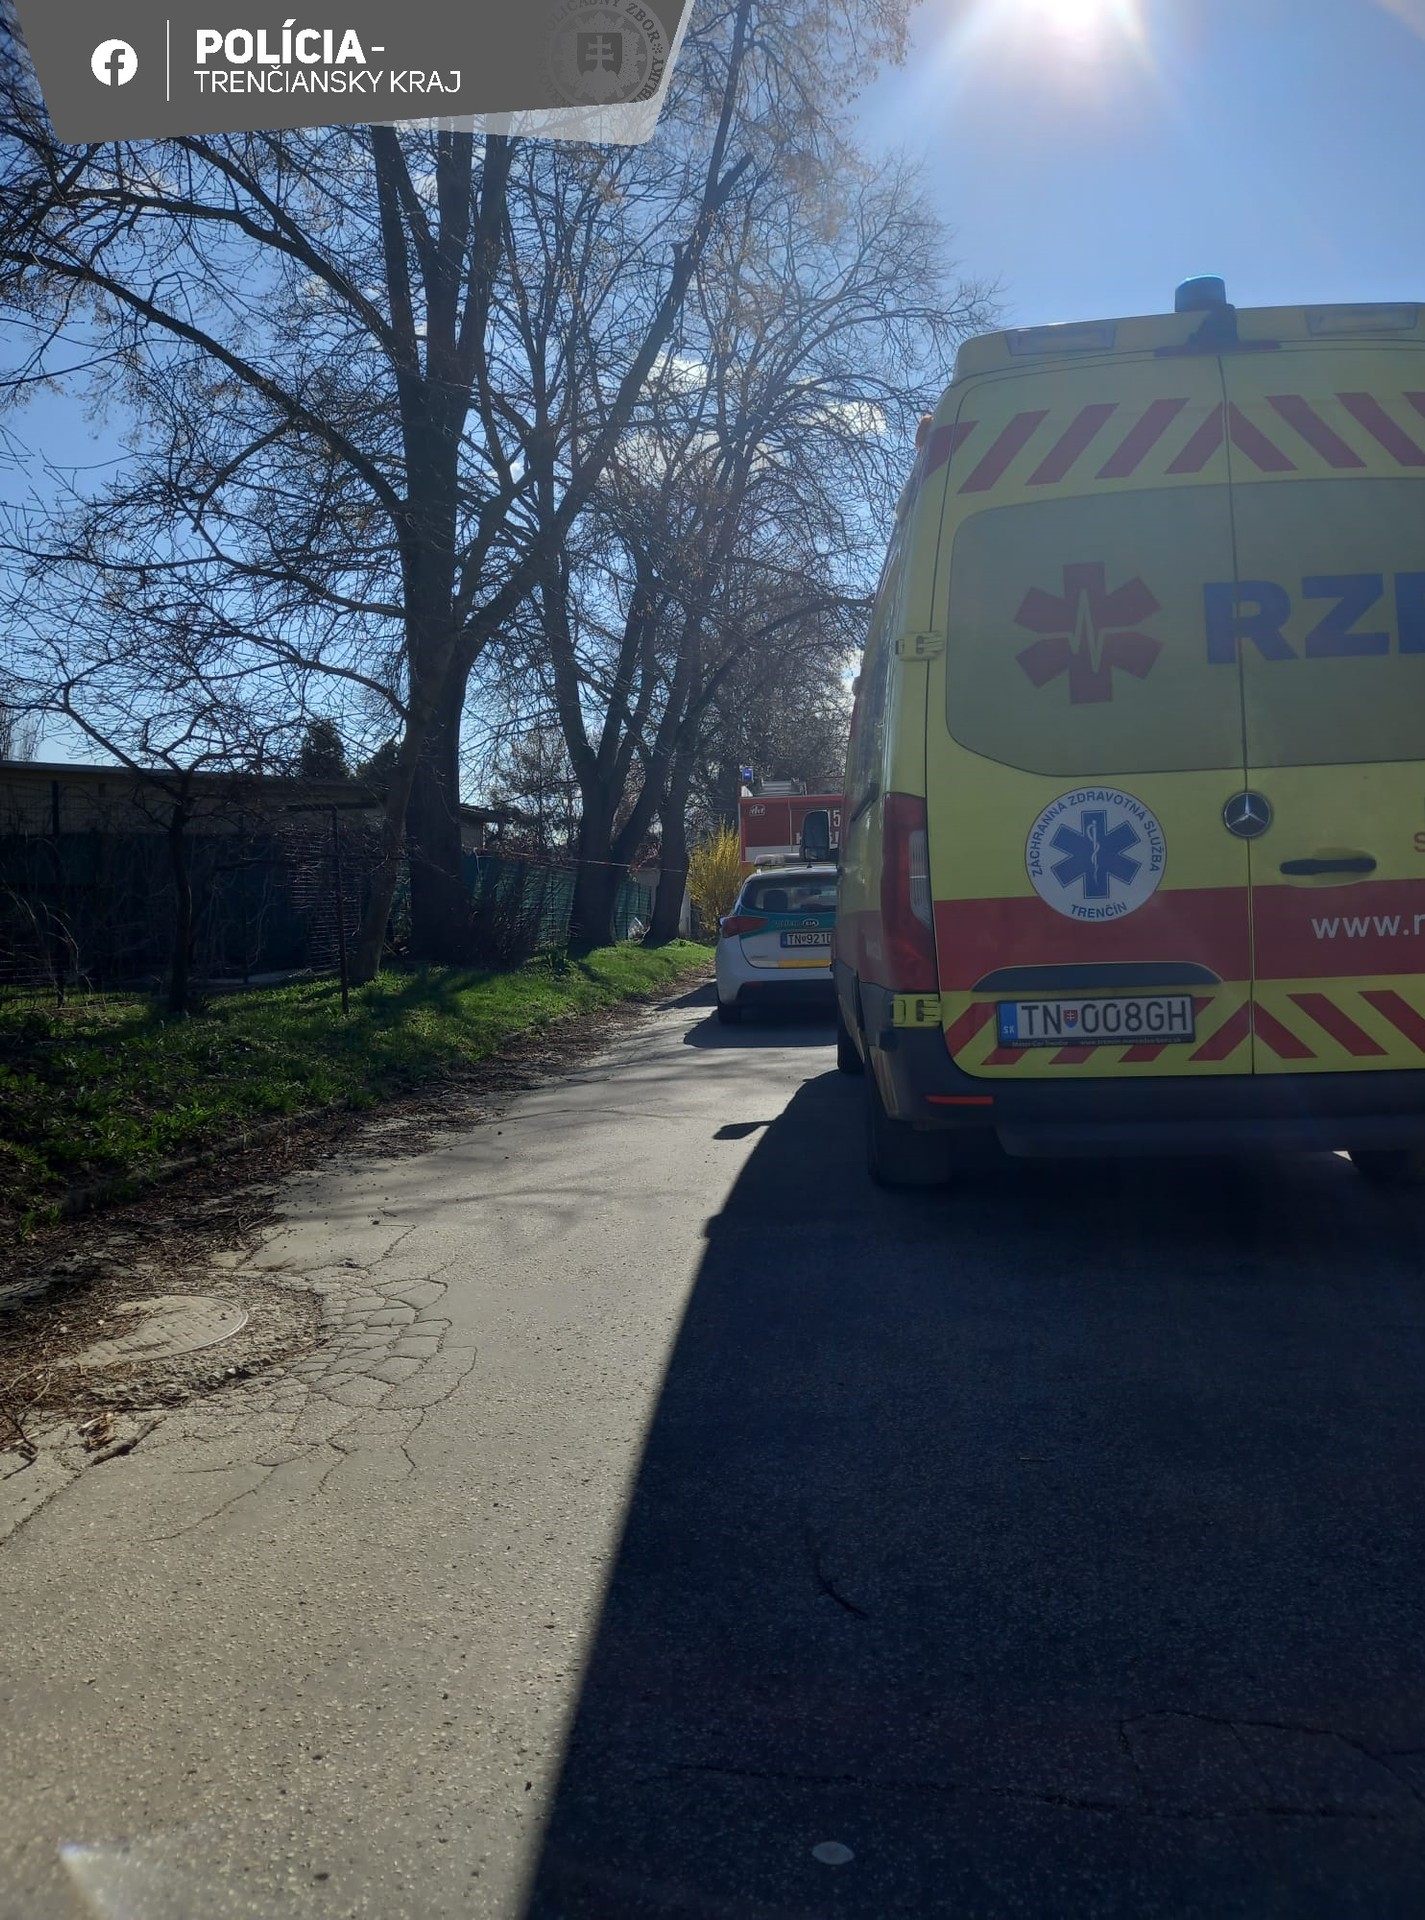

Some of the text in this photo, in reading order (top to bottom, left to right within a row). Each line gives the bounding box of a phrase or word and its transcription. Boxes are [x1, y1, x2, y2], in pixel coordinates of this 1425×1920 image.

[1068, 790, 1146, 822] ZDRAVOTNÁ
[1143, 820, 1165, 872] SLUŽBA
[1070, 902, 1128, 919] TRENČÍN
[1003, 1025, 1016, 1035] SK
